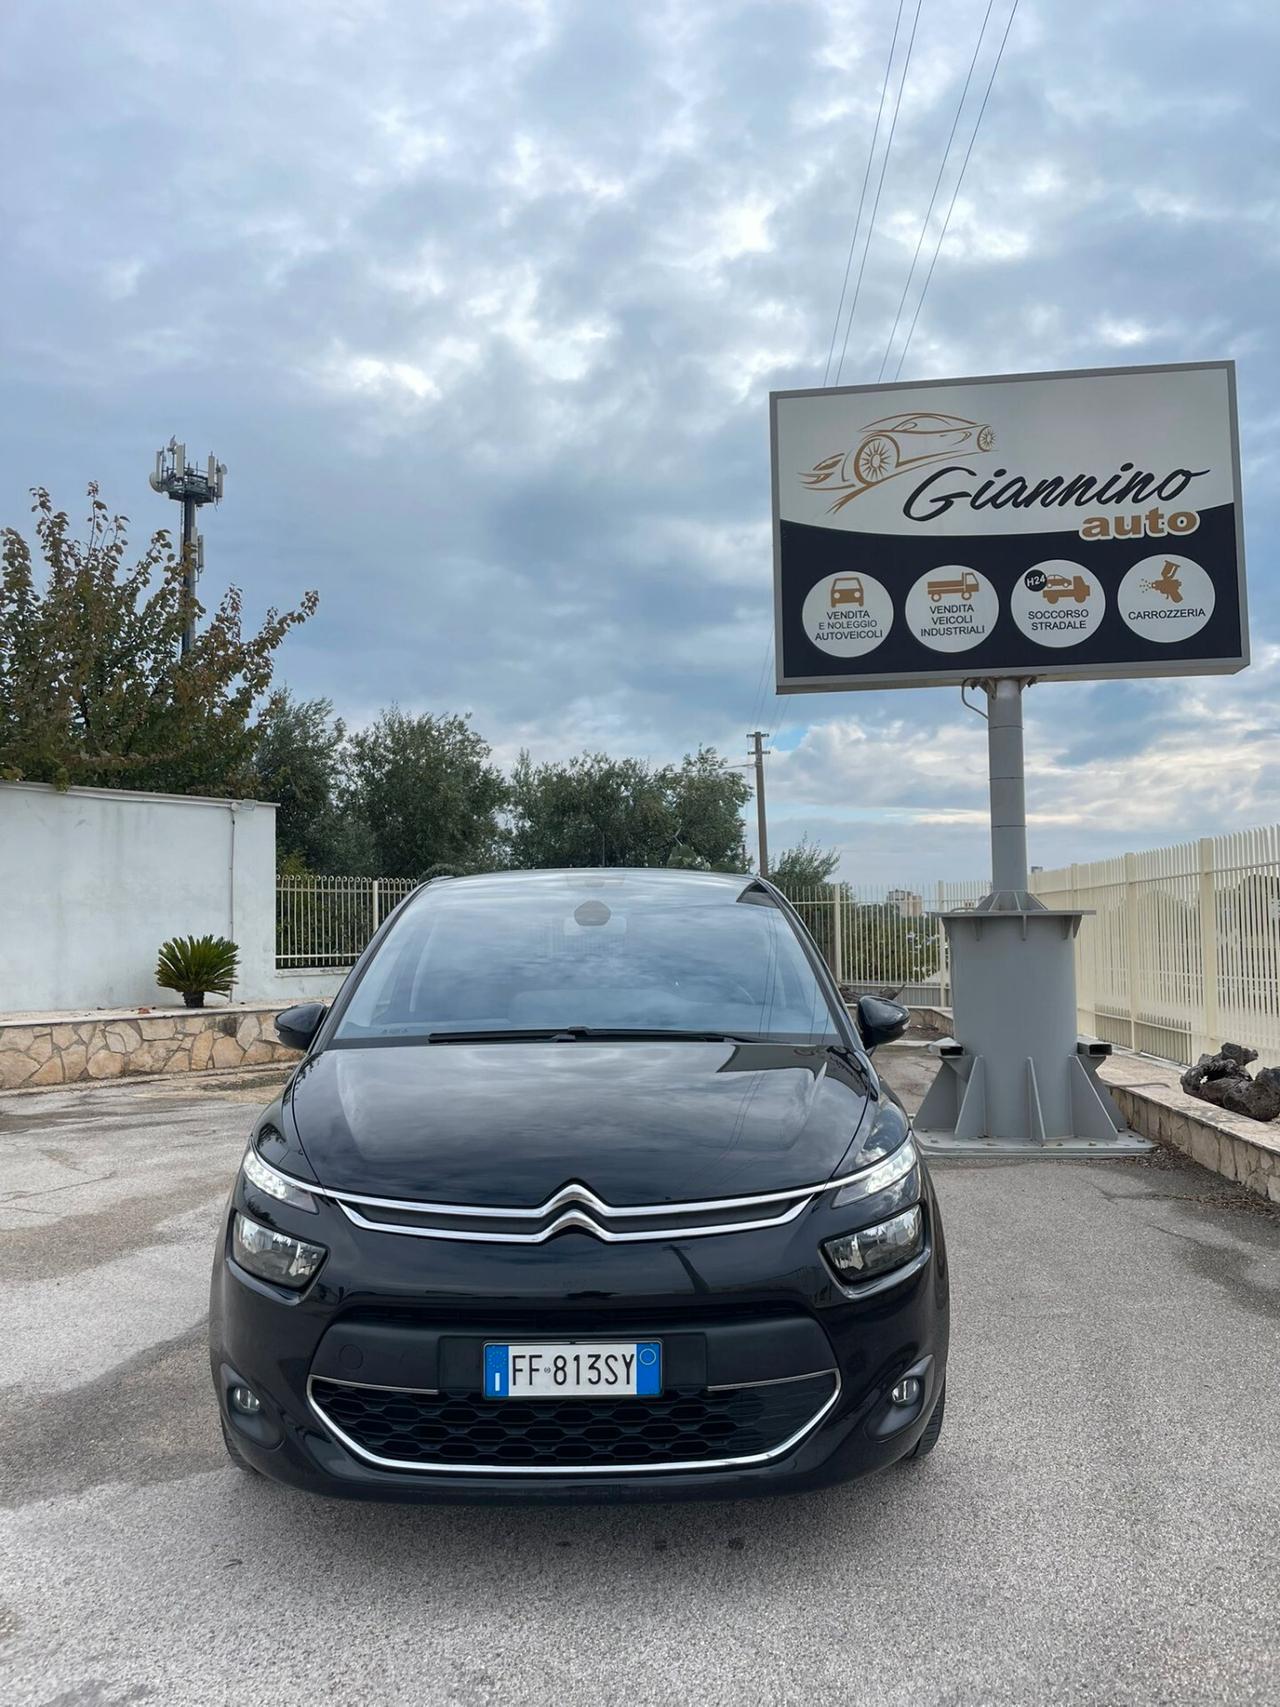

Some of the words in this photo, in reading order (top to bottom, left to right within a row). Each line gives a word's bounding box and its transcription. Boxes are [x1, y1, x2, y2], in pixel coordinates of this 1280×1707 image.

[903, 462, 1211, 522] Giannino
[1080, 506, 1199, 539] auto
[1026, 574, 1046, 587] H24
[929, 604, 974, 614] VENDITA
[1028, 609, 1089, 620] SOCCORSO
[1128, 608, 1206, 620] CARROZZERIA
[826, 610, 870, 620] VENDITA
[932, 615, 972, 625] VEICOLI
[818, 622, 824, 630] E
[827, 619, 878, 630] NOLEGGIO
[1031, 620, 1087, 631] STRADALE
[814, 630, 883, 641] AUTOVEICOLI
[920, 625, 985, 637] INDUSTRIALI
